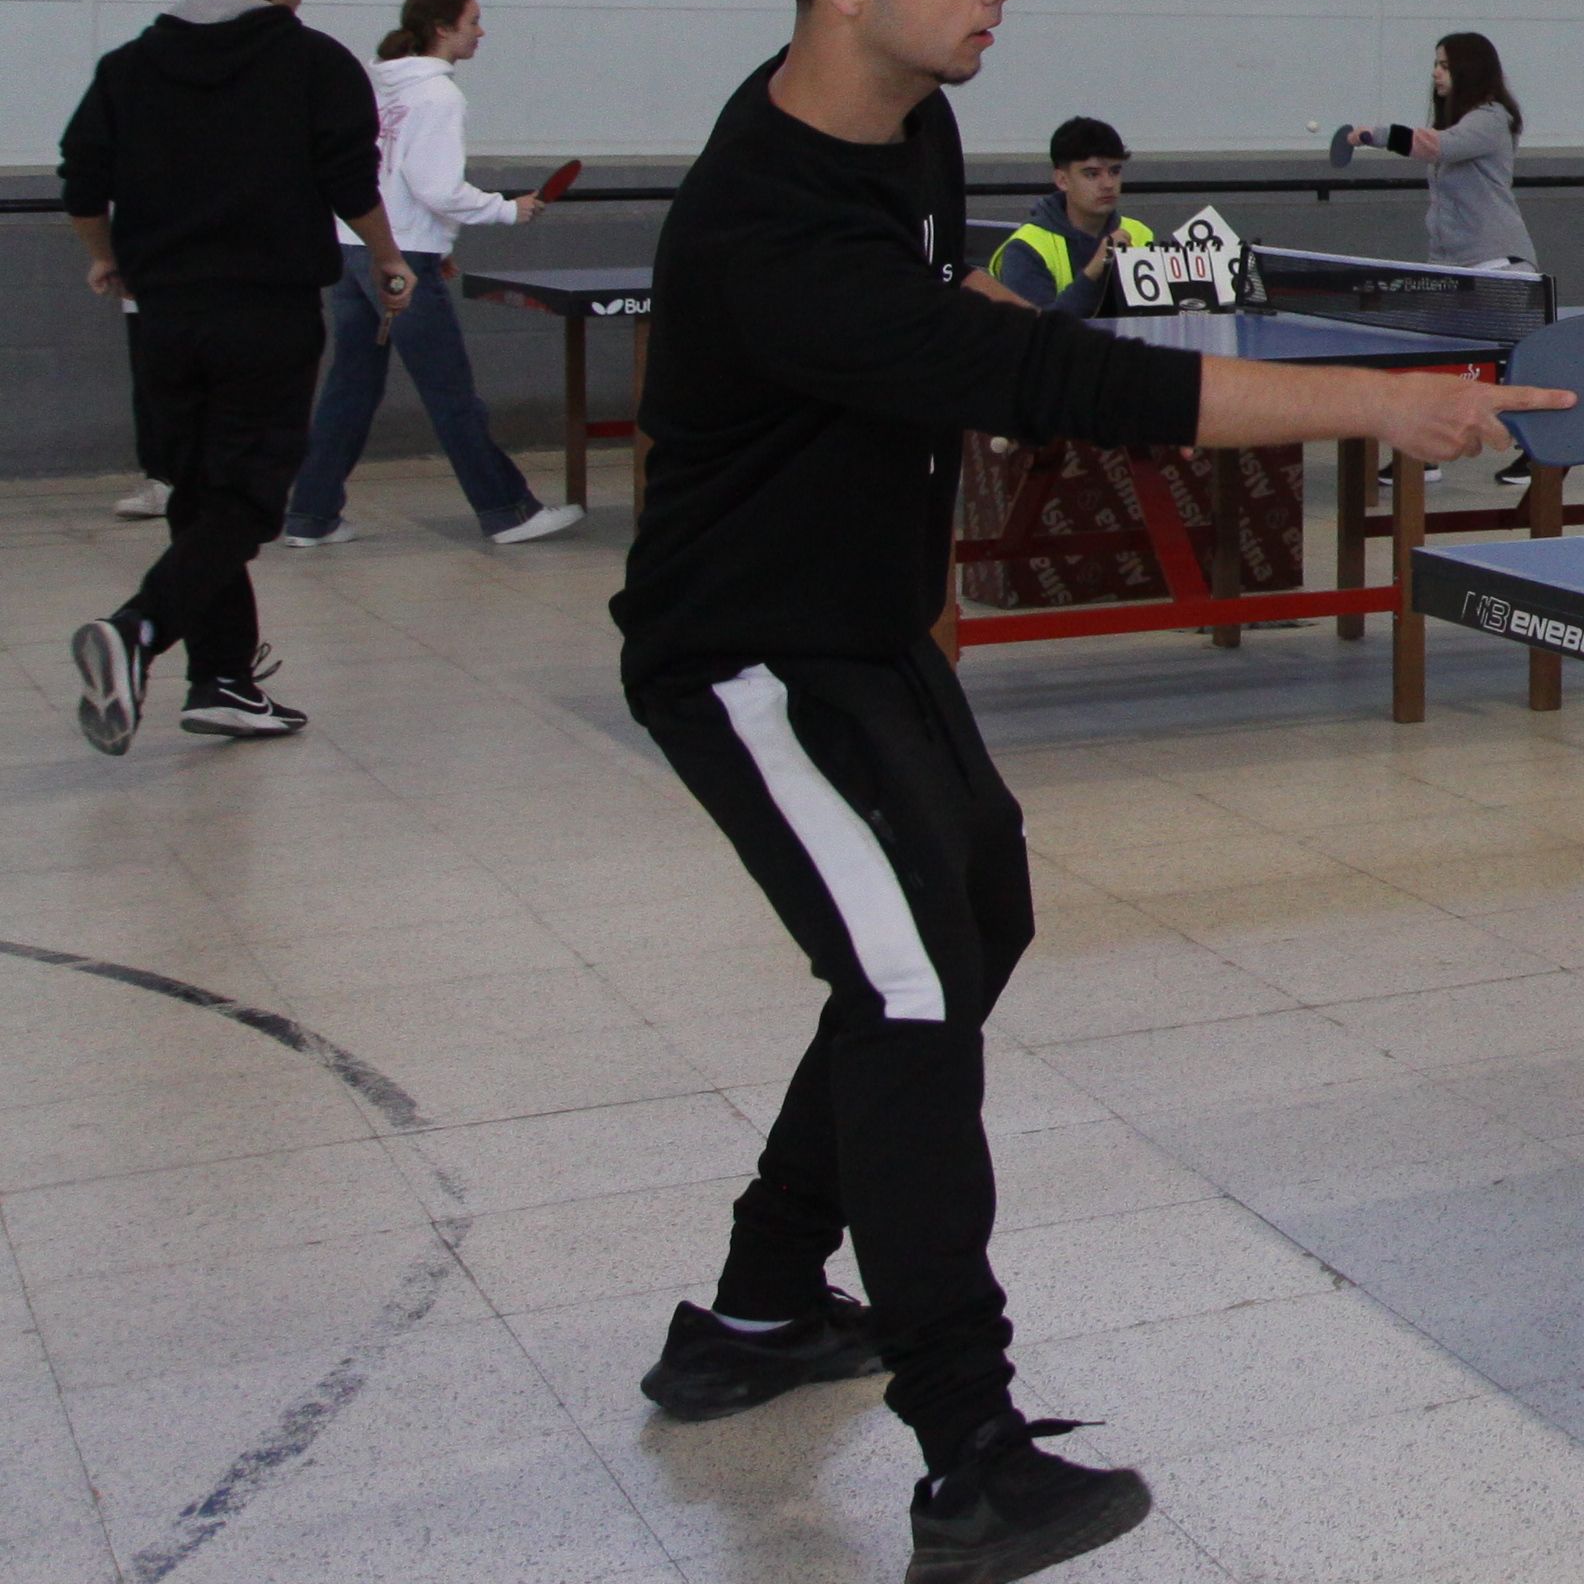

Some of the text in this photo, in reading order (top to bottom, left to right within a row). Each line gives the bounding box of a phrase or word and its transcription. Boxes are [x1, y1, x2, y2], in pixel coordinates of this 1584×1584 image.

[1133, 260, 1160, 302] 6
[1170, 256, 1182, 279] 0
[1196, 256, 1206, 278] 0
